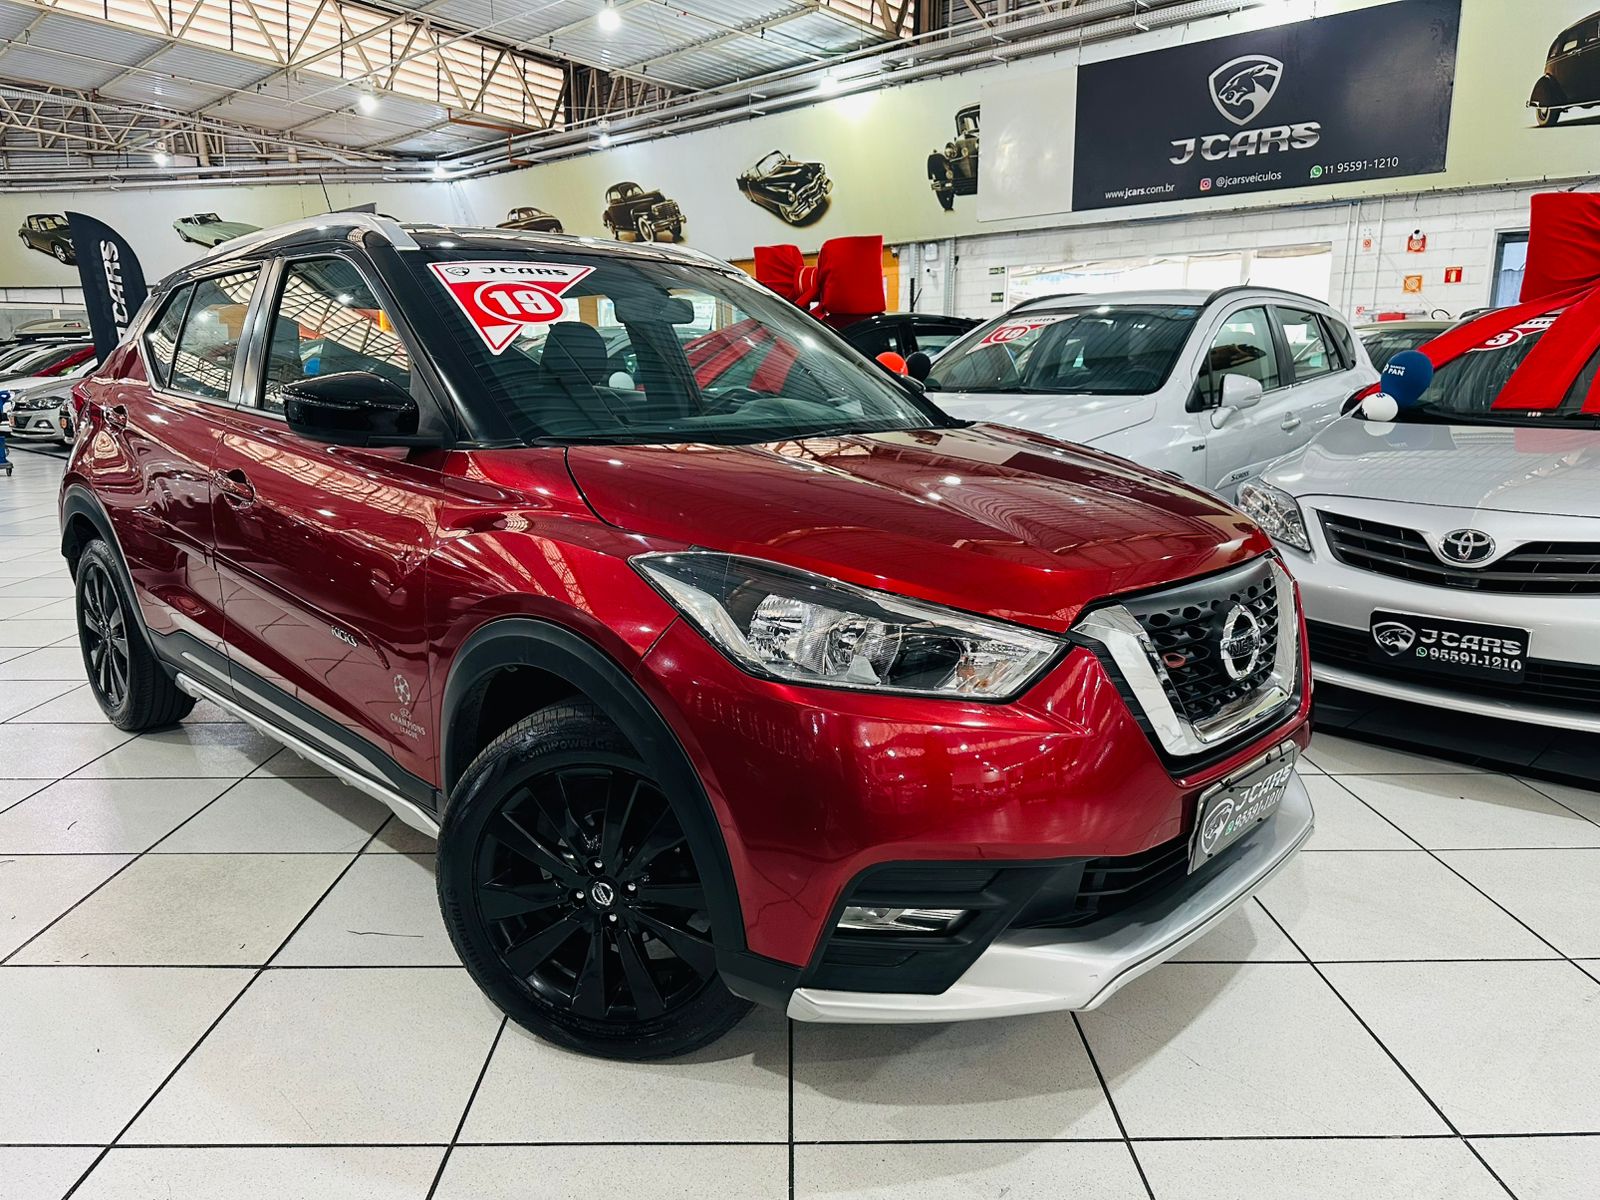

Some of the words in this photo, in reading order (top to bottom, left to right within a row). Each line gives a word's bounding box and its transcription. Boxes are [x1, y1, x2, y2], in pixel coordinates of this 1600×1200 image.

[1324, 165, 1334, 175] 11
[1337, 156, 1399, 173] 95591-1210
[1215, 170, 1282, 187] @jcarsveiculos
[1105, 183, 1175, 199] www.jcars.com.br
[488, 290, 556, 315] 19
[1388, 368, 1405, 376] PAN
[1429, 647, 1522, 672] 95591-1210
